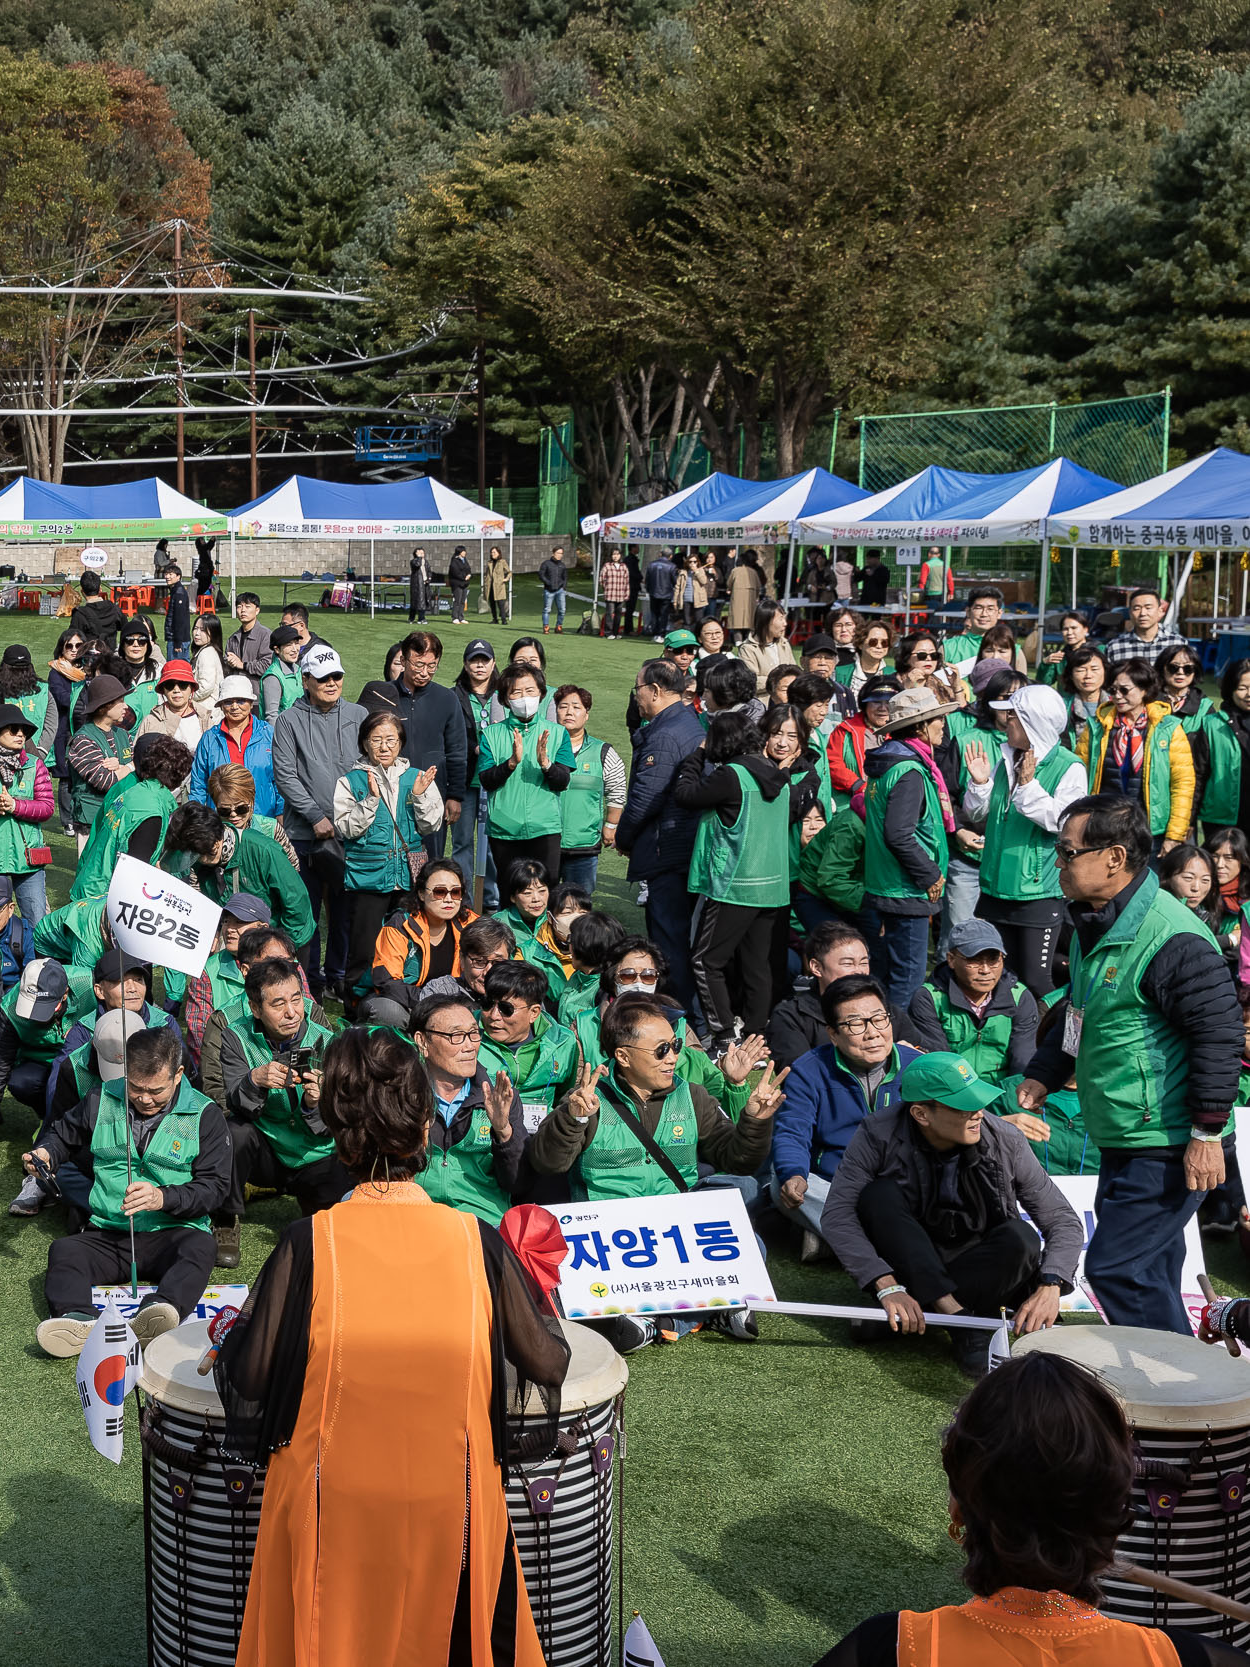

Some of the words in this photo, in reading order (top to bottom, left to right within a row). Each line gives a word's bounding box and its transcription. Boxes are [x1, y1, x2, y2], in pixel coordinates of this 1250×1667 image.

[38, 523, 74, 535] 구의2동
[629, 527, 650, 539] 군자동
[1089, 524, 1136, 545] 함께하는
[1140, 525, 1188, 545] 중곡4동
[114, 900, 201, 950] 자양2동
[575, 1213, 600, 1222] 광진구
[564, 1220, 741, 1272] 자양1동
[610, 1273, 740, 1295] (사)서울광진구새마을회
